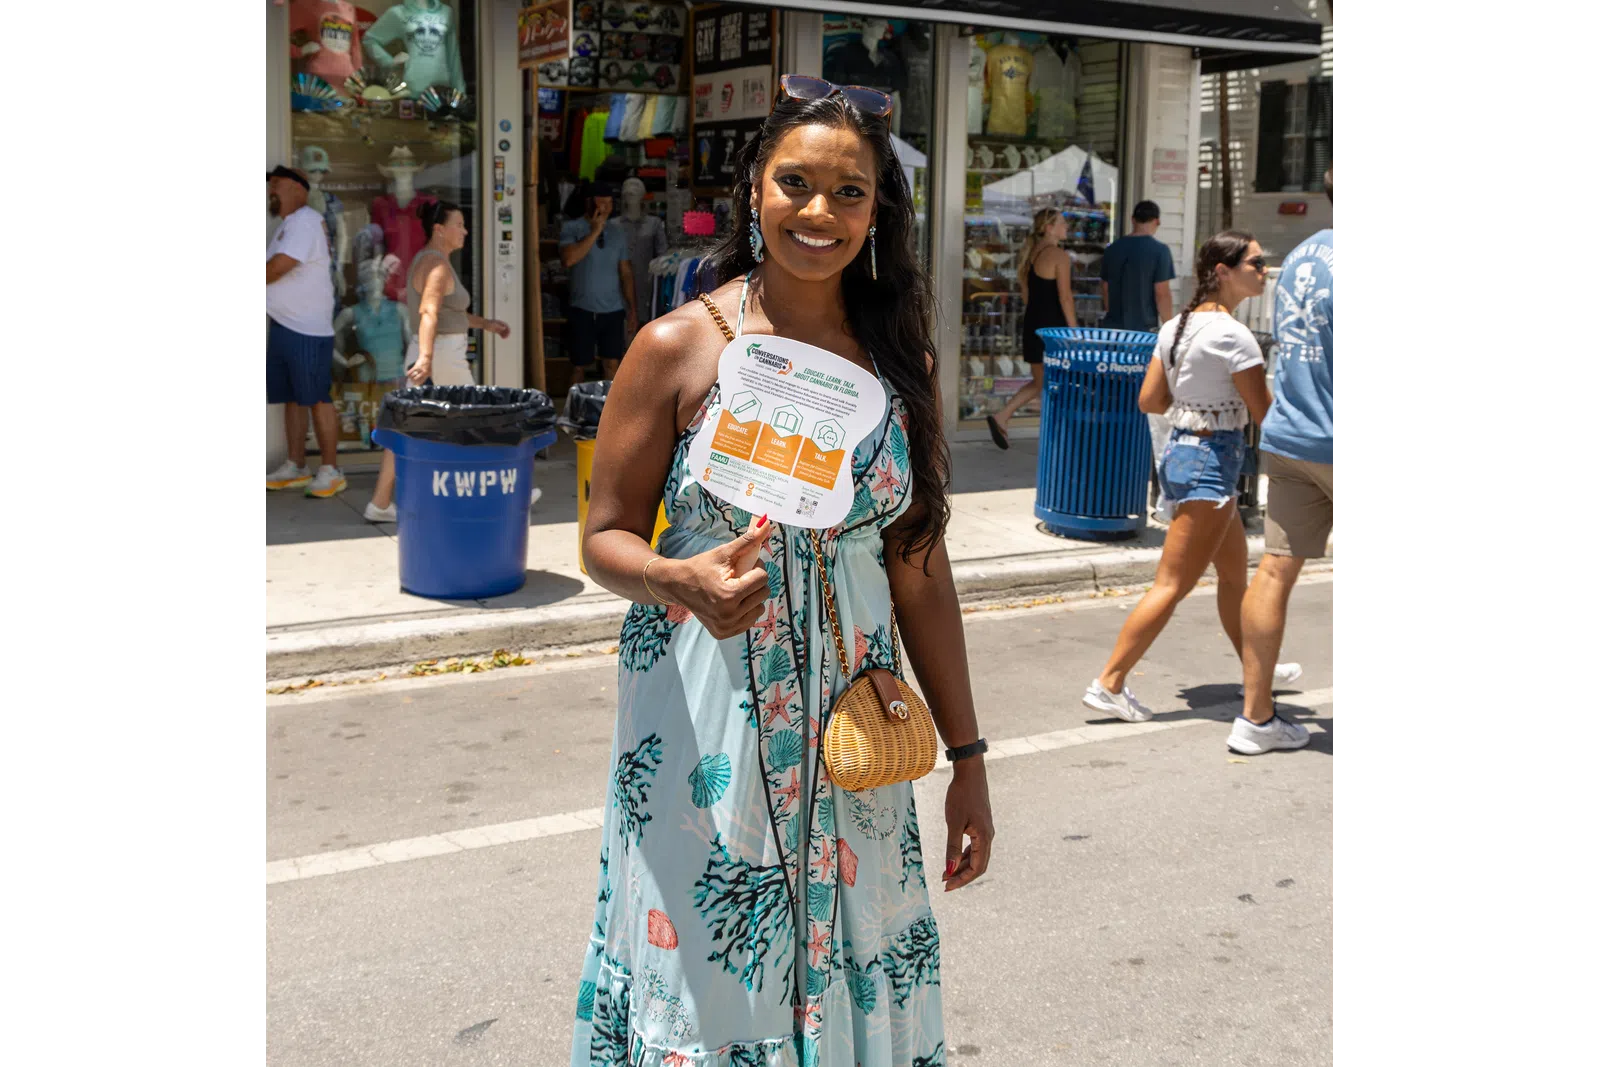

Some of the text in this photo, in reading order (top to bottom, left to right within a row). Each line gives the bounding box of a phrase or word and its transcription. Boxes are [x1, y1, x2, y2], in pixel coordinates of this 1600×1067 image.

[751, 347, 788, 364] CONVERSATIONS
[758, 356, 782, 369] CANNABIS
[1109, 362, 1144, 374] Recycle
[793, 371, 809, 381] ABOUT
[808, 376, 833, 389] CANNABIS
[838, 386, 860, 398] FLORIDA.
[803, 367, 855, 389] EDUCATE. LEARN. TALK
[726, 422, 749, 435] EDUCATE.
[770, 437, 787, 448] LEARN.
[710, 453, 728, 463] FAMU
[813, 452, 827, 462] TALK.
[432, 467, 518, 498] KWPW
